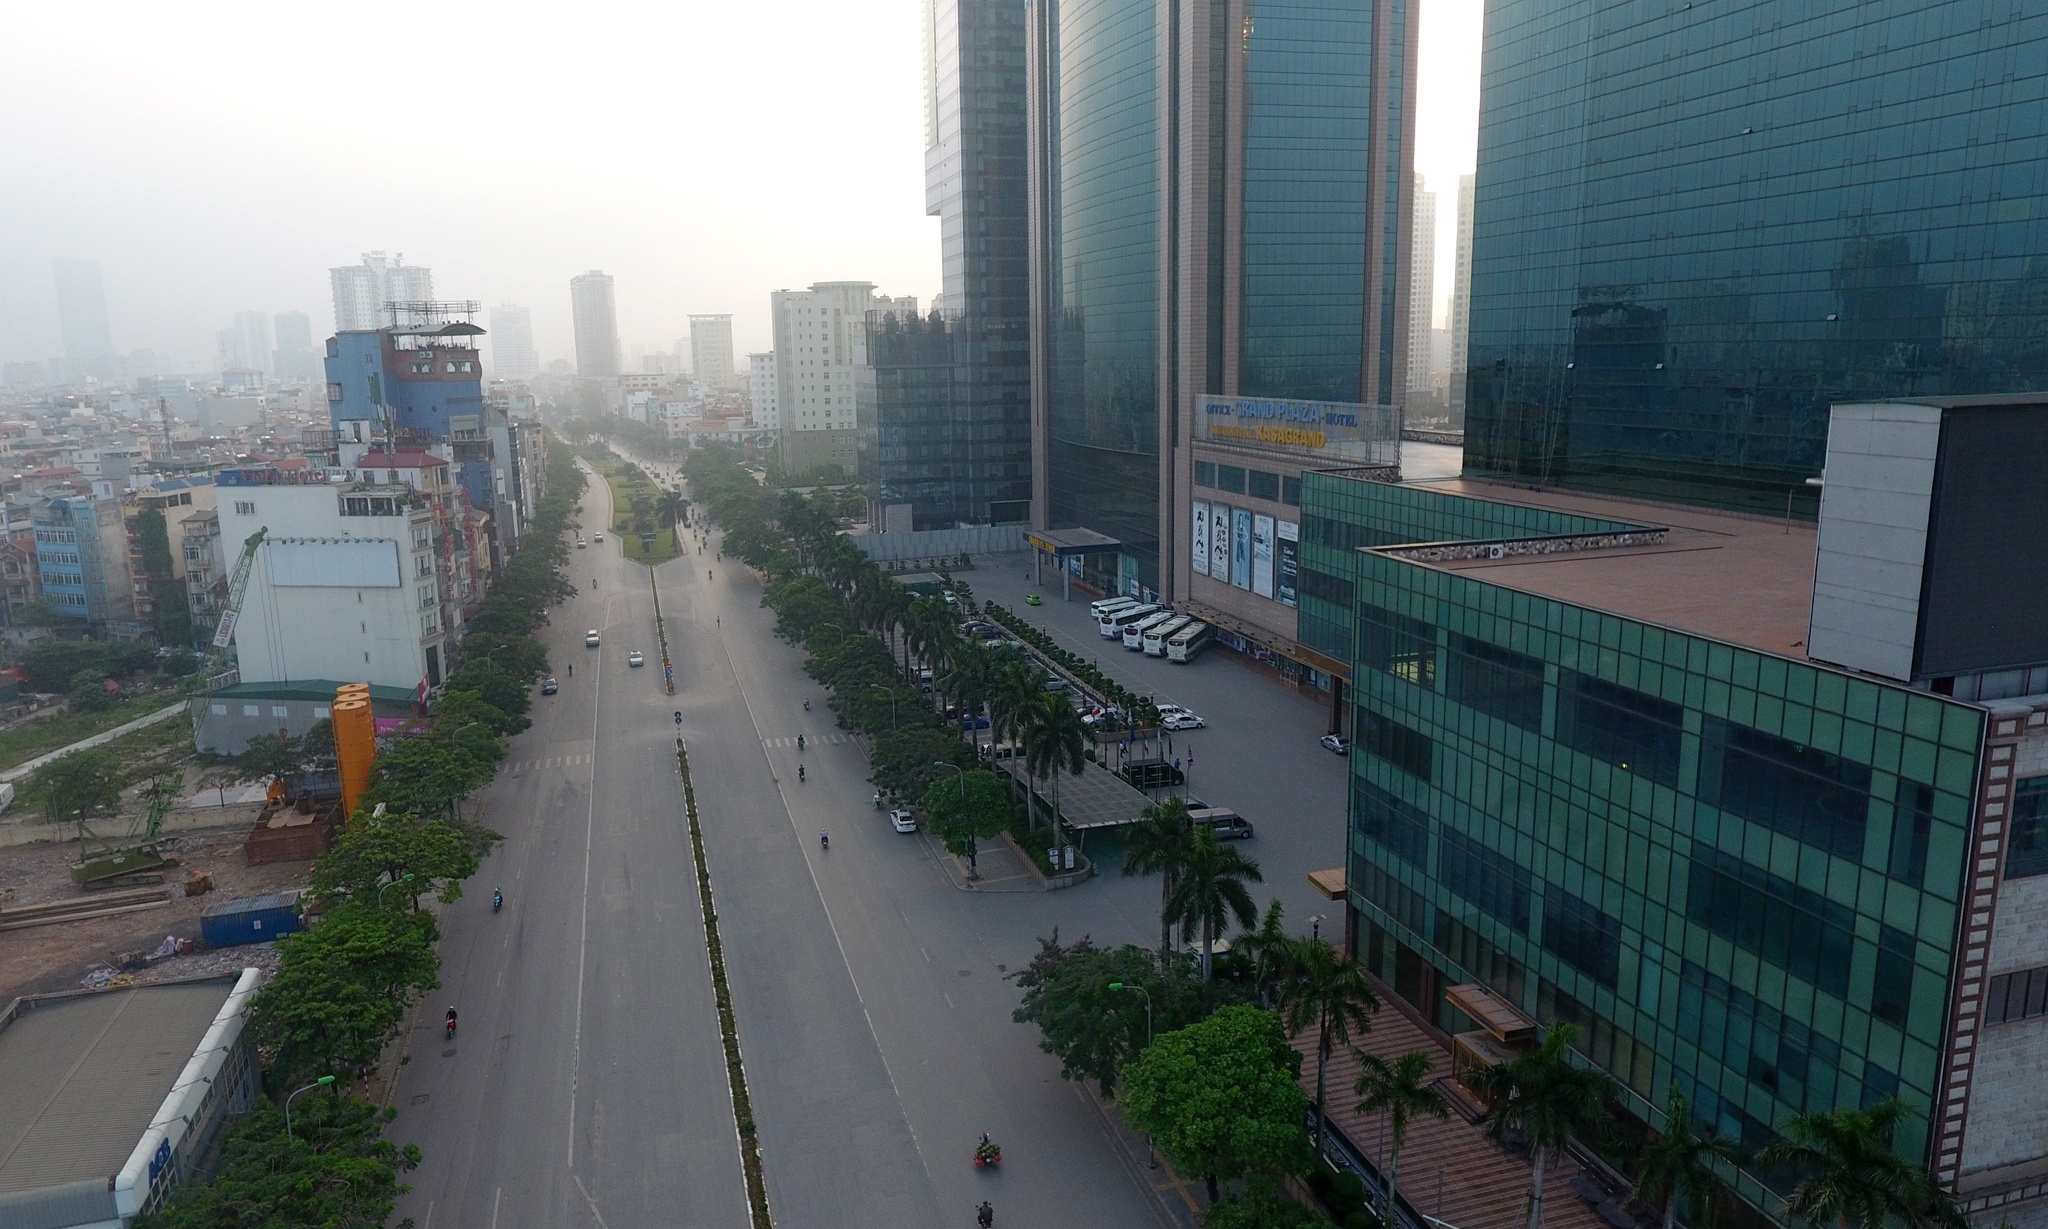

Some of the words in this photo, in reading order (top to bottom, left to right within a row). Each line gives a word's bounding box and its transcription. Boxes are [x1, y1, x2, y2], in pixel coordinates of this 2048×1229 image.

[1234, 400, 1275, 419] GRAND
[1277, 401, 1321, 424] PLAZA
[1325, 413, 1358, 428] HOTEL
[1256, 425, 1327, 449] KASAGRAND
